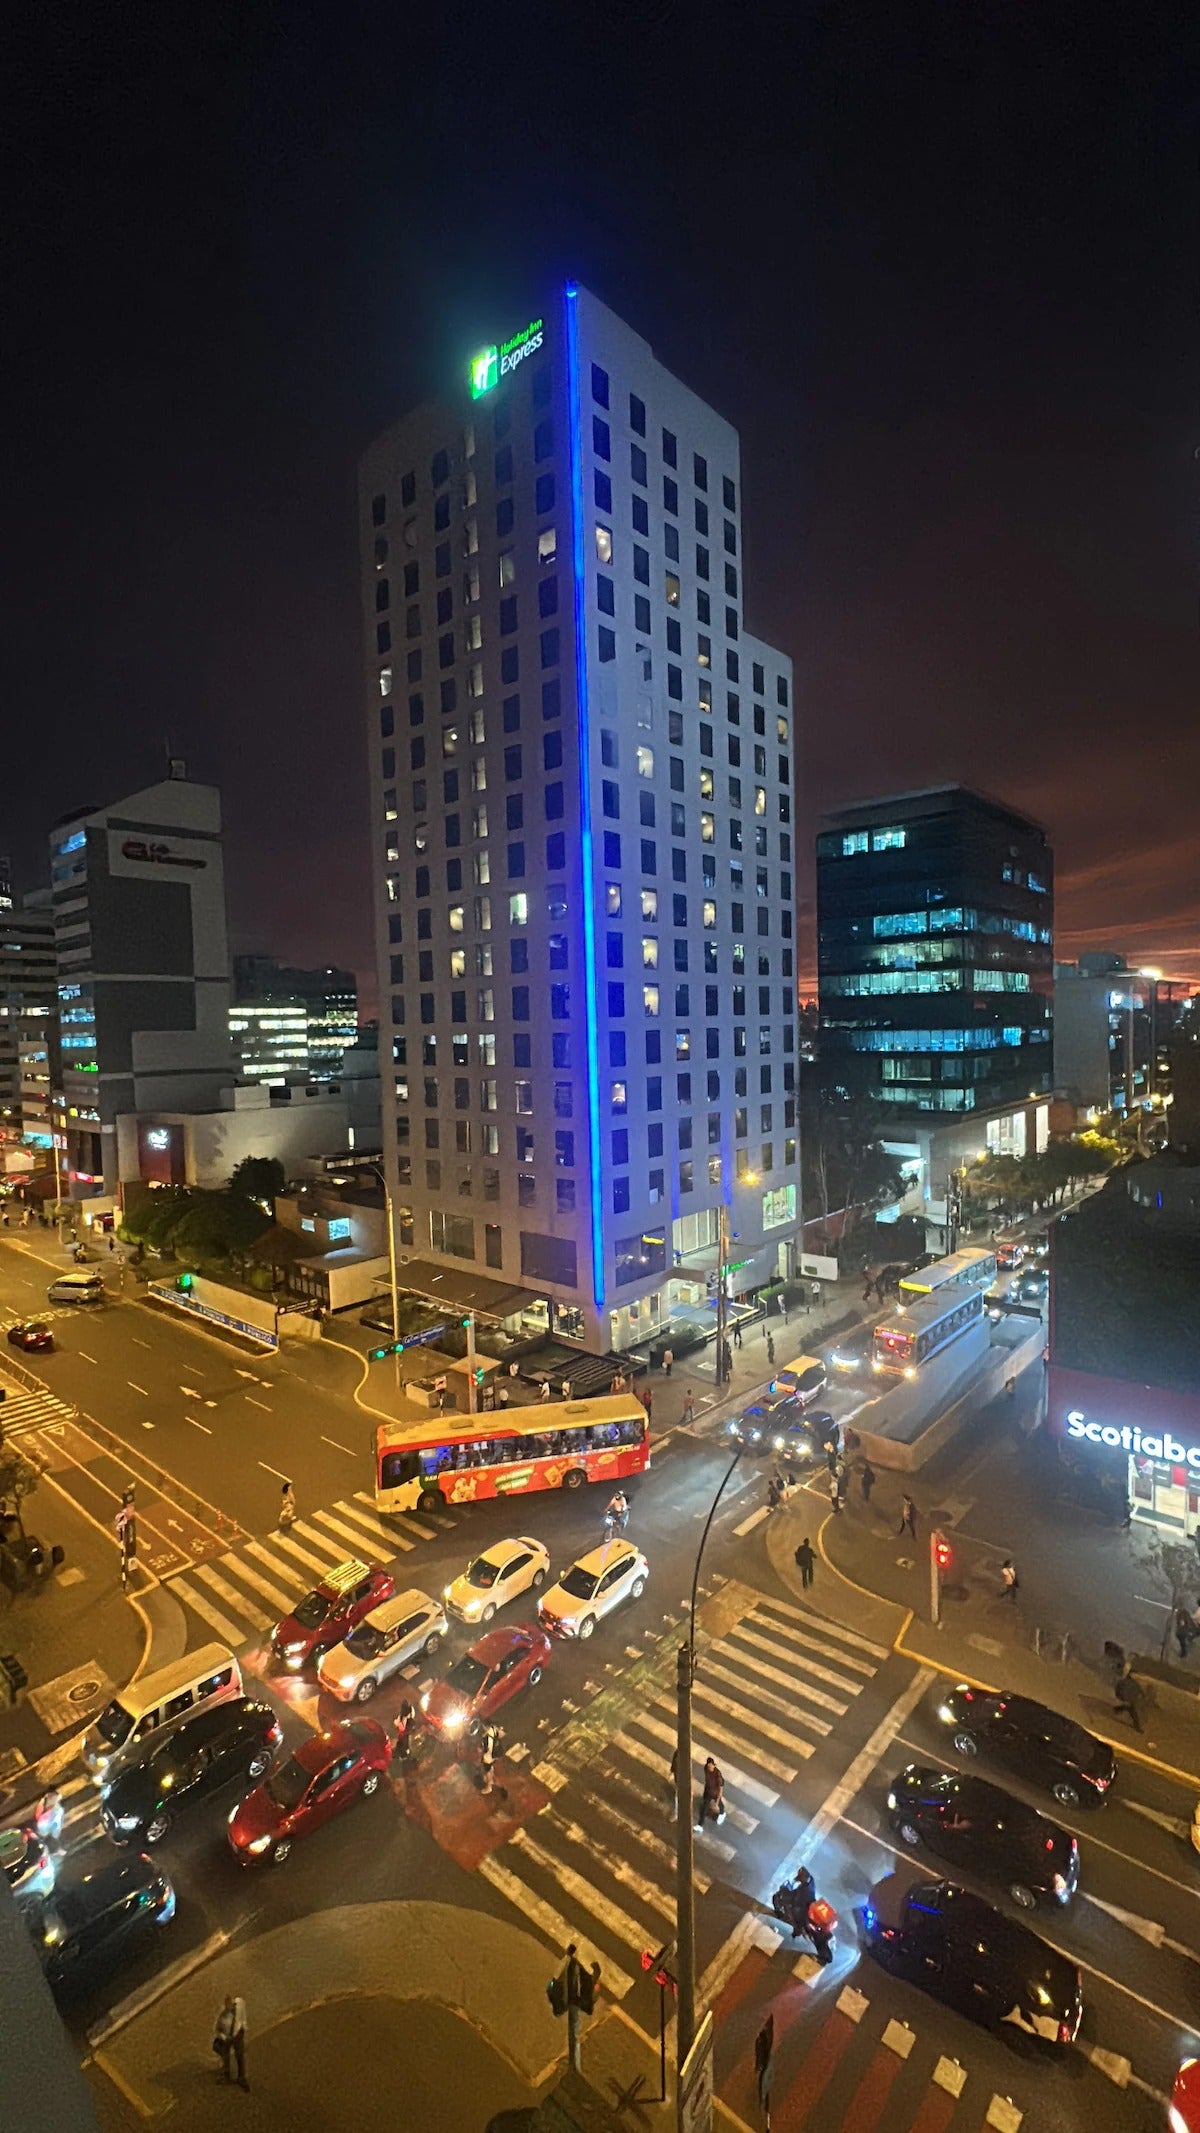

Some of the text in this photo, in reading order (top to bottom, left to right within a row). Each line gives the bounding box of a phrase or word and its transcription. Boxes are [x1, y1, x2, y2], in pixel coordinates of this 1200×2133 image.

[500, 319, 543, 356] Holiday Inn
[500, 331, 544, 376] Express
